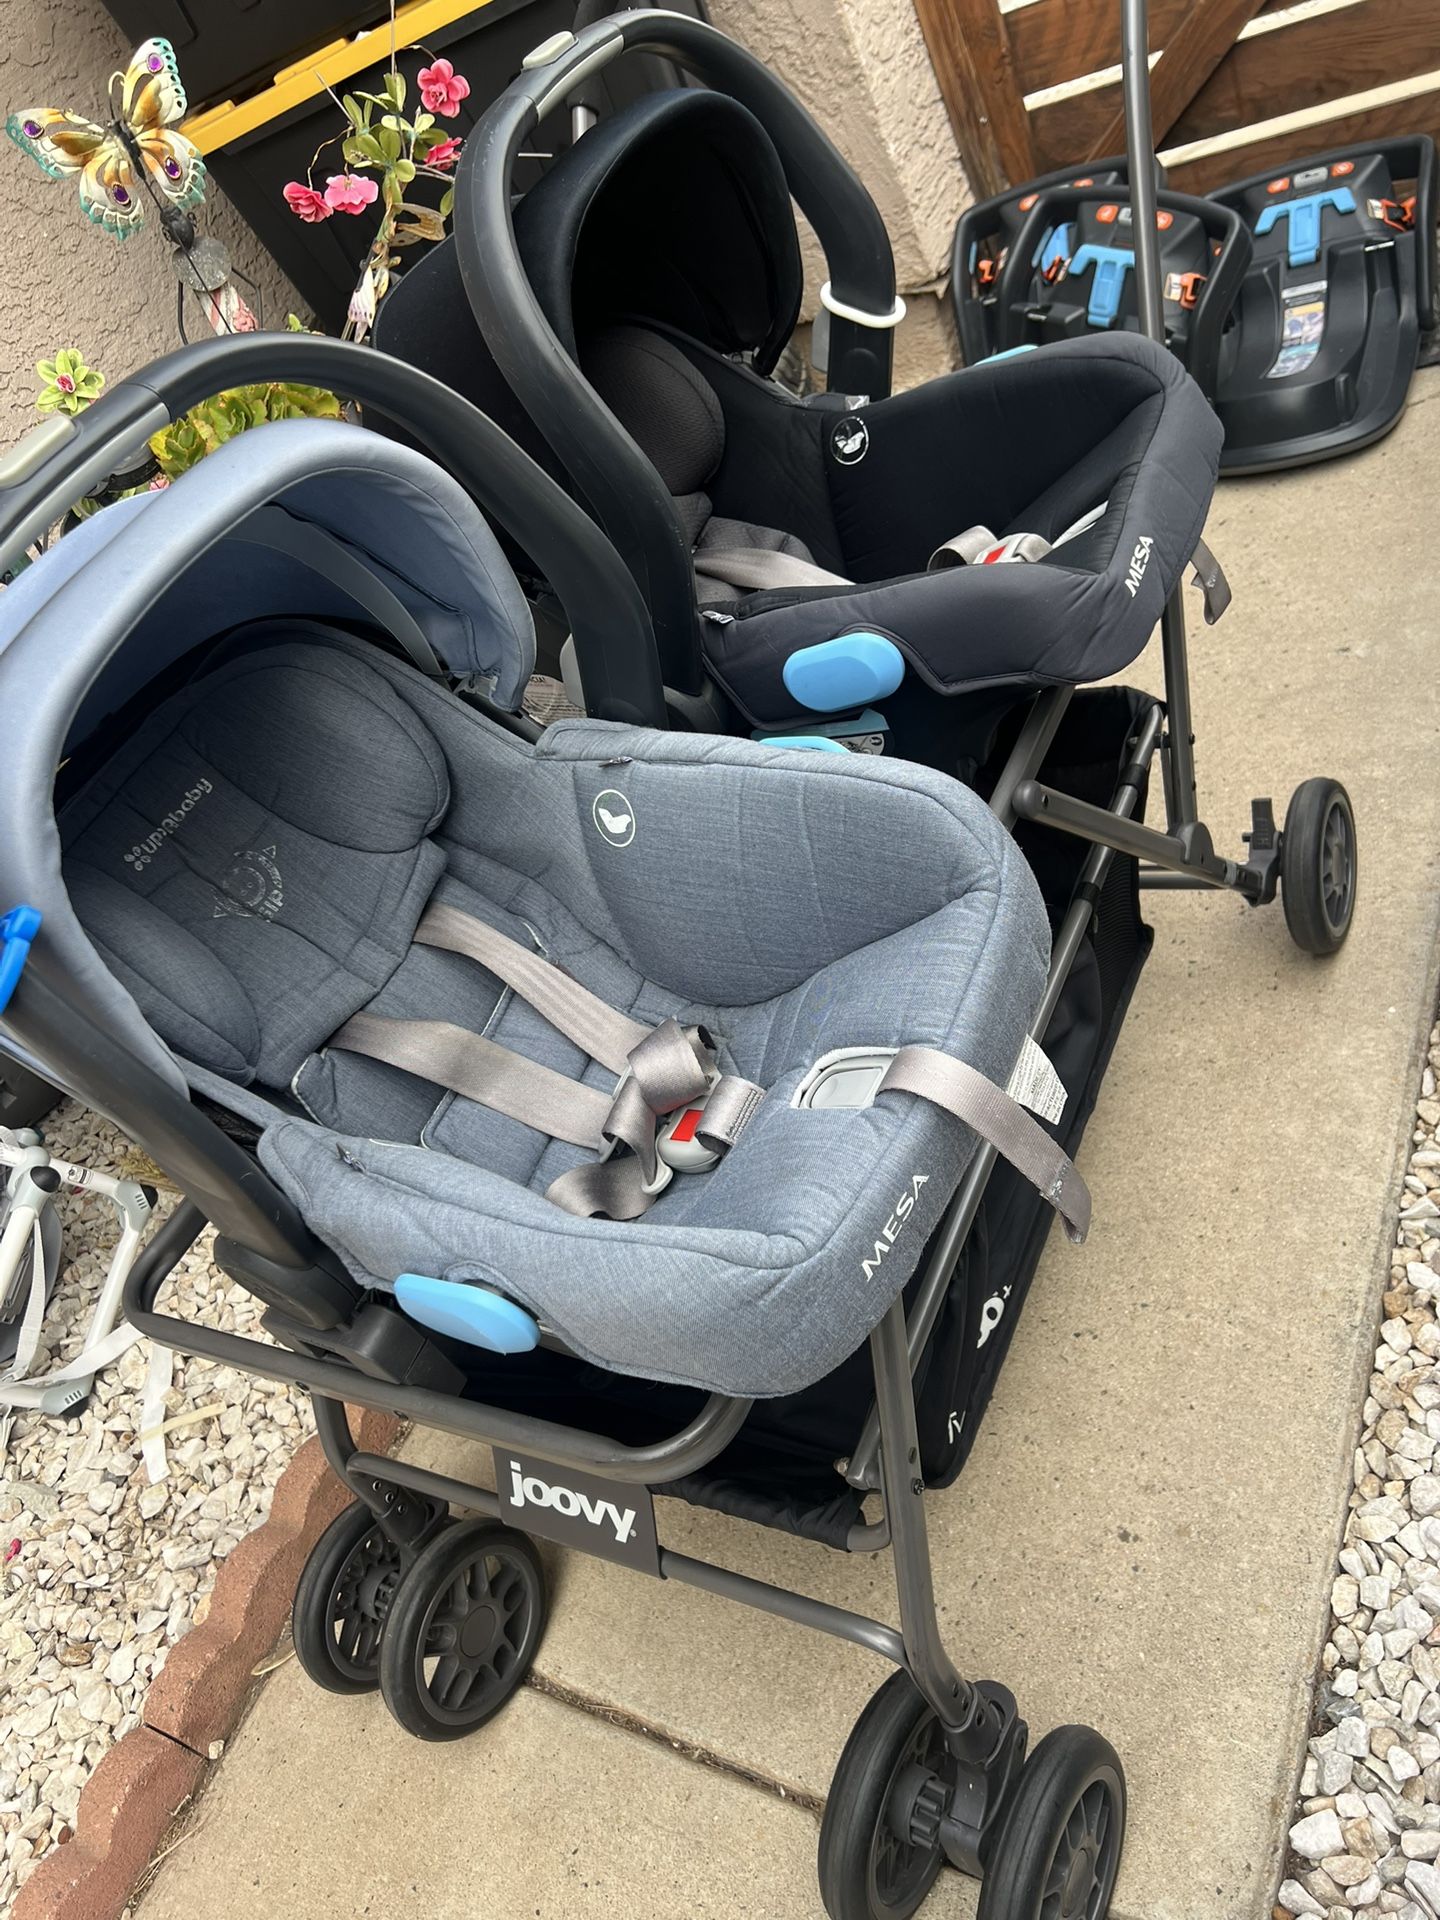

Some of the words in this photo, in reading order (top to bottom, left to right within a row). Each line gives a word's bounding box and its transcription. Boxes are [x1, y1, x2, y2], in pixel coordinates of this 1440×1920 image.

[1124, 535, 1154, 598] MESA
[861, 1174, 930, 1282] MESA
[510, 1460, 636, 1544] joovy
